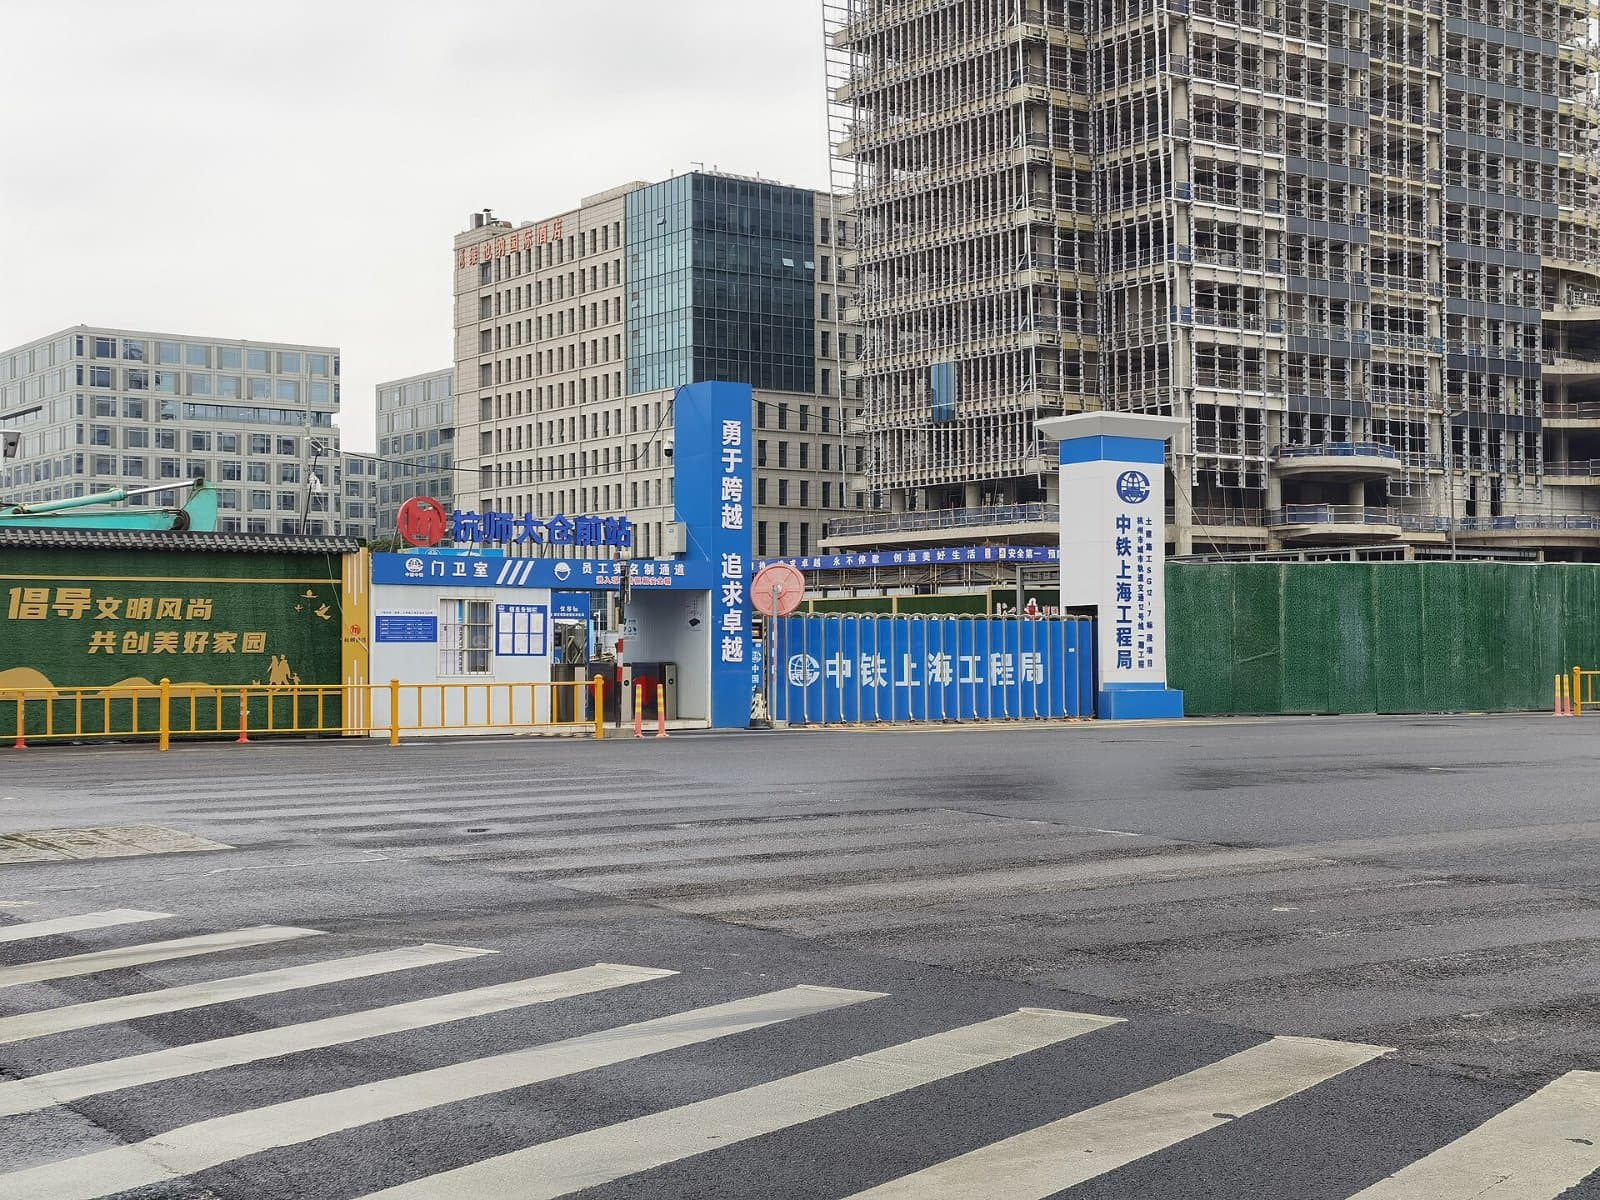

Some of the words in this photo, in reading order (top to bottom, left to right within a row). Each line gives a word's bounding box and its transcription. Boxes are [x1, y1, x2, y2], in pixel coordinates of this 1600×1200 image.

[721, 419, 743, 530] 勇于跨越
[452, 510, 632, 548] 杭师大仓前站
[431, 560, 489, 578] 门卫室
[582, 562, 685, 576] 员工实名制通道
[833, 554, 880, 566] 永不停歇
[893, 549, 976, 563] 创造美好生活
[1008, 548, 1042, 559] 安全第一
[7, 587, 214, 621] 倡导文明风尚
[721, 552, 744, 663] 追求卓越
[1115, 513, 1132, 670] 中铁上海工程局
[87, 631, 267, 655] 共创美好家园
[825, 651, 1044, 689] 中铁上海工程局
